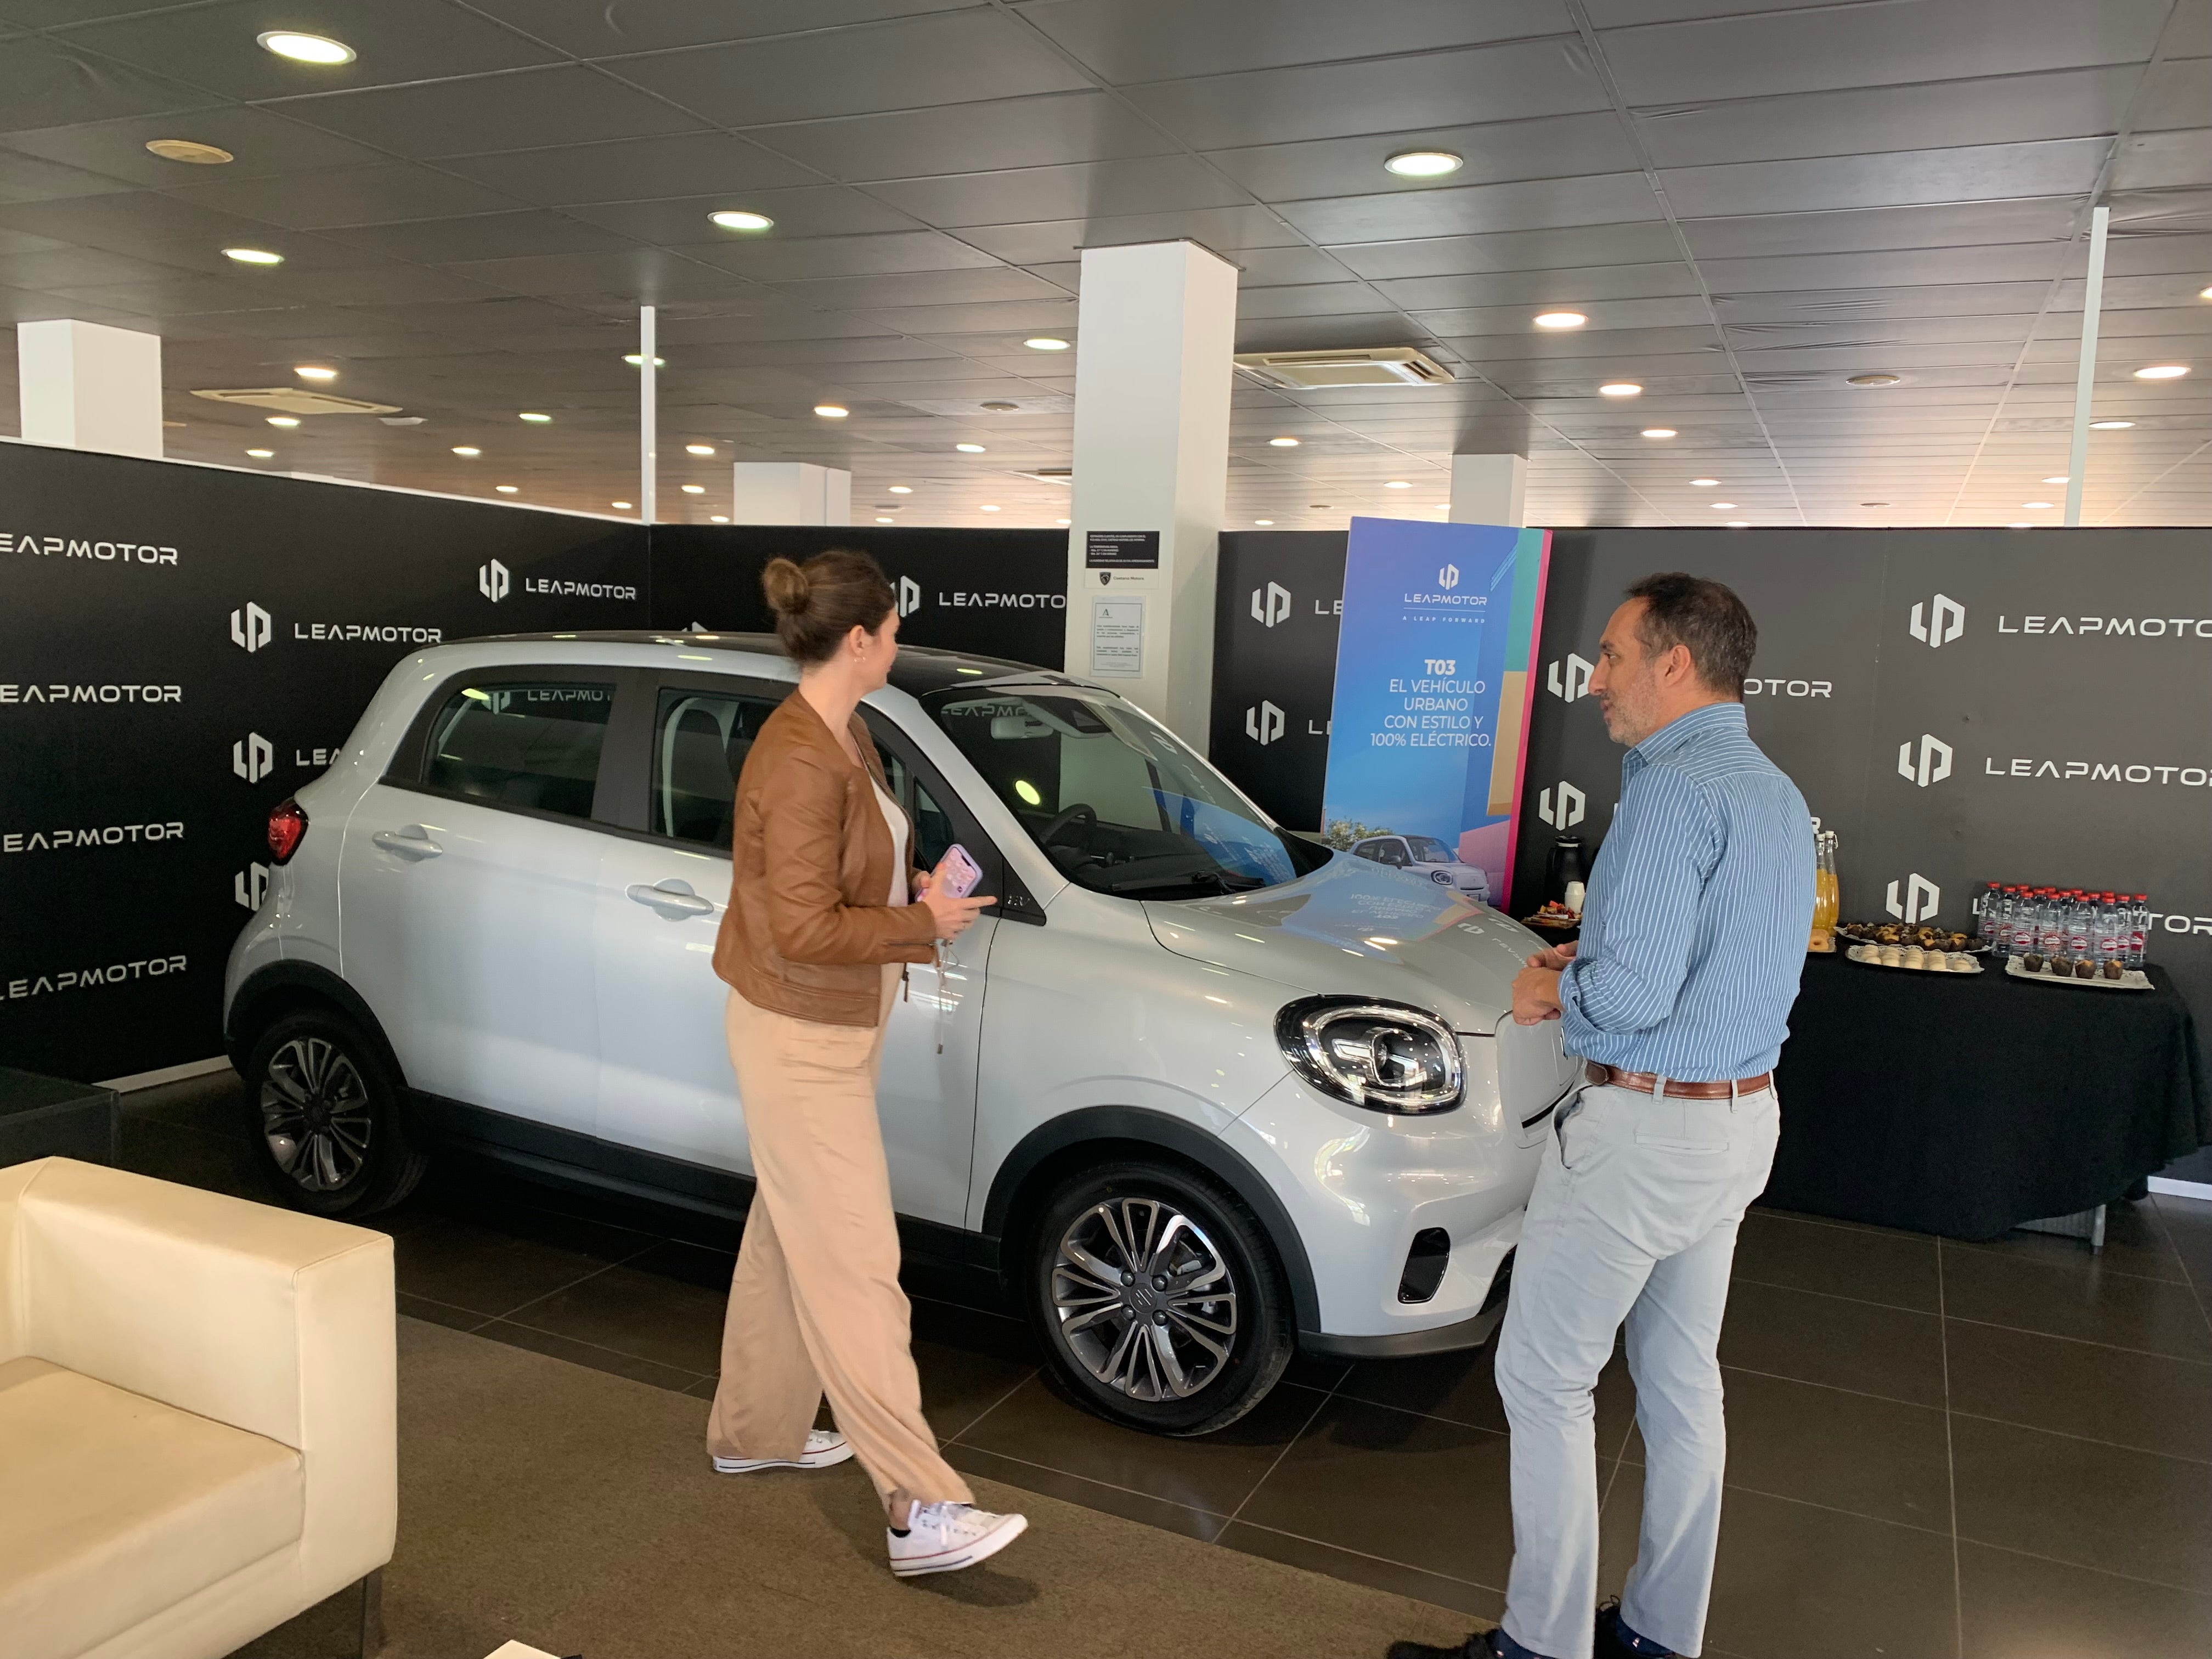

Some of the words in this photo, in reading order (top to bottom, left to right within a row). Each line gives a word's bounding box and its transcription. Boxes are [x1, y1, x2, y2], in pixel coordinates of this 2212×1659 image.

[526, 577, 636, 600] LEAPMOTOR
[1404, 593, 1487, 606] LEAPMOTOR
[294, 623, 442, 644] LEAPMOTOR
[1424, 659, 1456, 675] T03
[1389, 679, 1407, 693] EL
[1410, 676, 1486, 694] VEHÍCULO
[1404, 697, 1468, 712] URBANO
[1384, 715, 1417, 729] CON
[1421, 715, 1471, 729] ESTILO
[1474, 716, 1484, 729] Y
[1370, 732, 1407, 747] 100%
[1410, 730, 1492, 747] ELÉCTRICO.
[1985, 757, 2212, 787] LEAPMOTO
[0, 955, 187, 1001] EAPMOTOR
